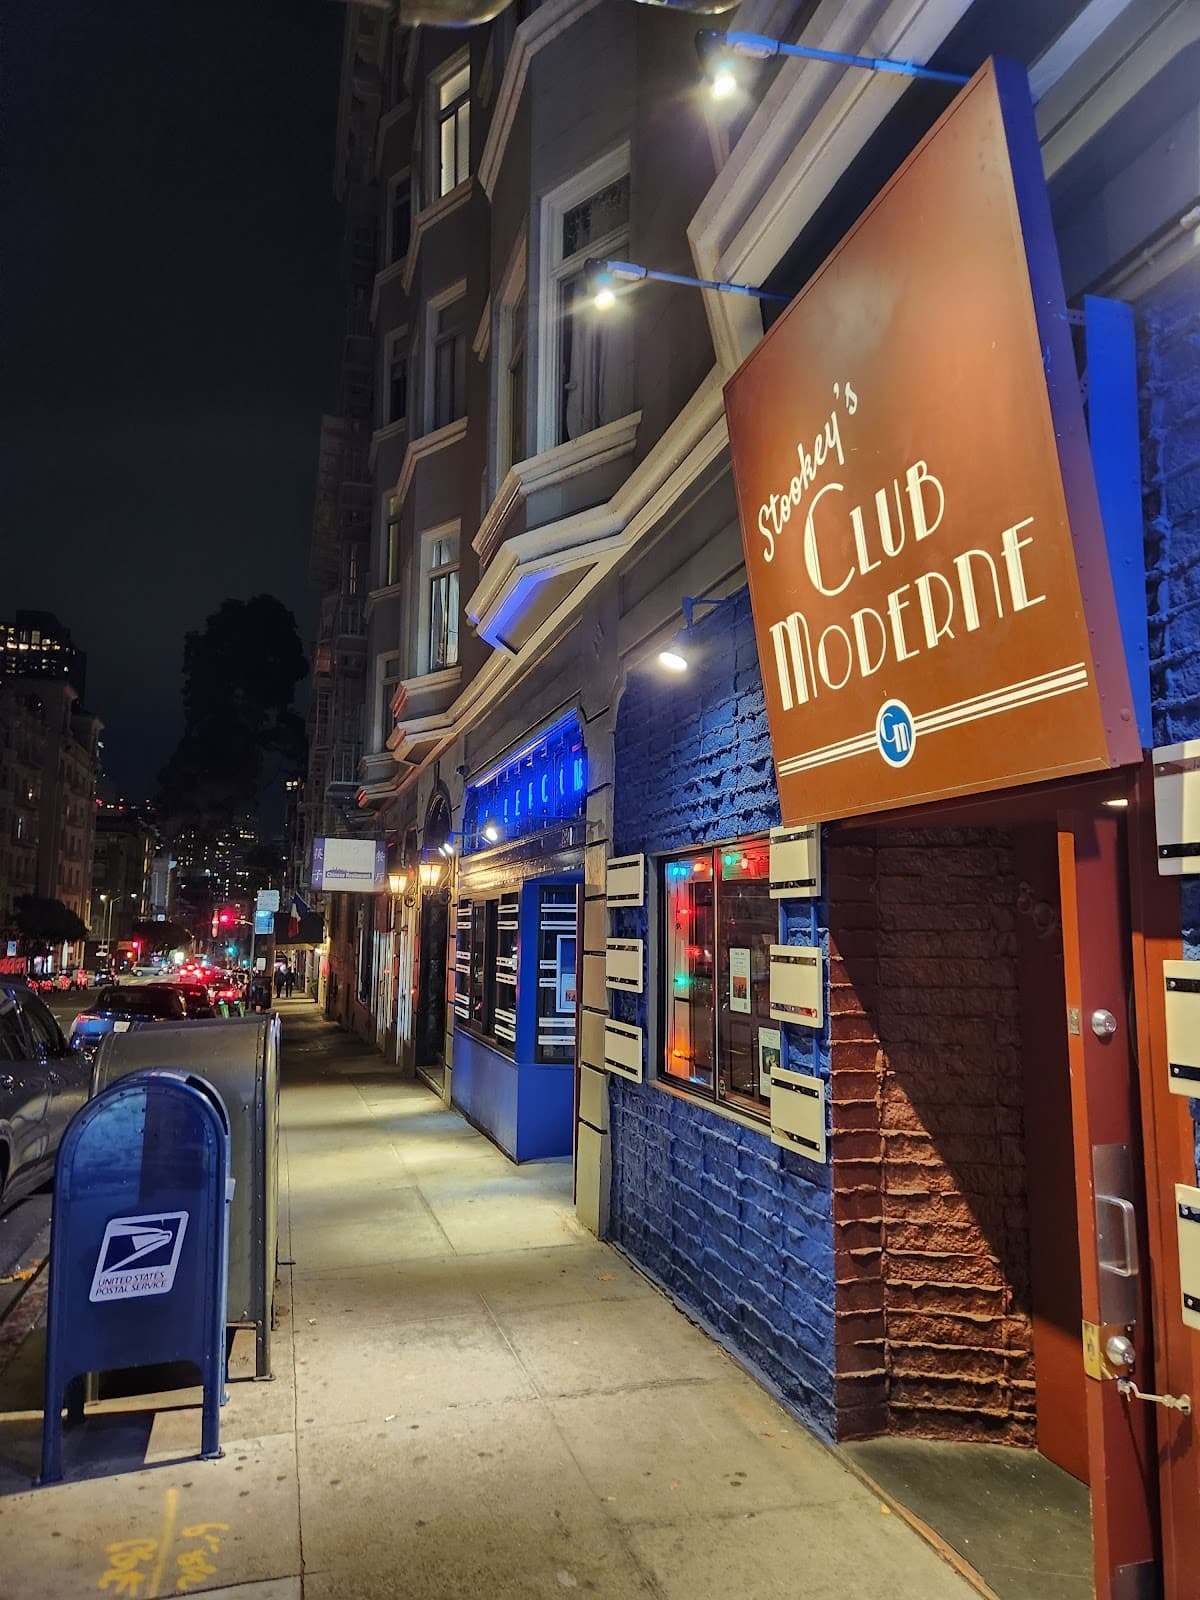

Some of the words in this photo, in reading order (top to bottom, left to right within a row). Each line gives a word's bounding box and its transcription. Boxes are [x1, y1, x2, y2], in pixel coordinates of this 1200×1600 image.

[757, 381, 859, 563] Stookey's
[803, 459, 945, 597] CLUB
[768, 516, 1047, 712] MODERNE
[95, 1285, 128, 1297] POSTAL
[131, 1280, 166, 1291] SERVICE
[98, 1275, 133, 1287] UNITED
[134, 1271, 165, 1281] STATES
